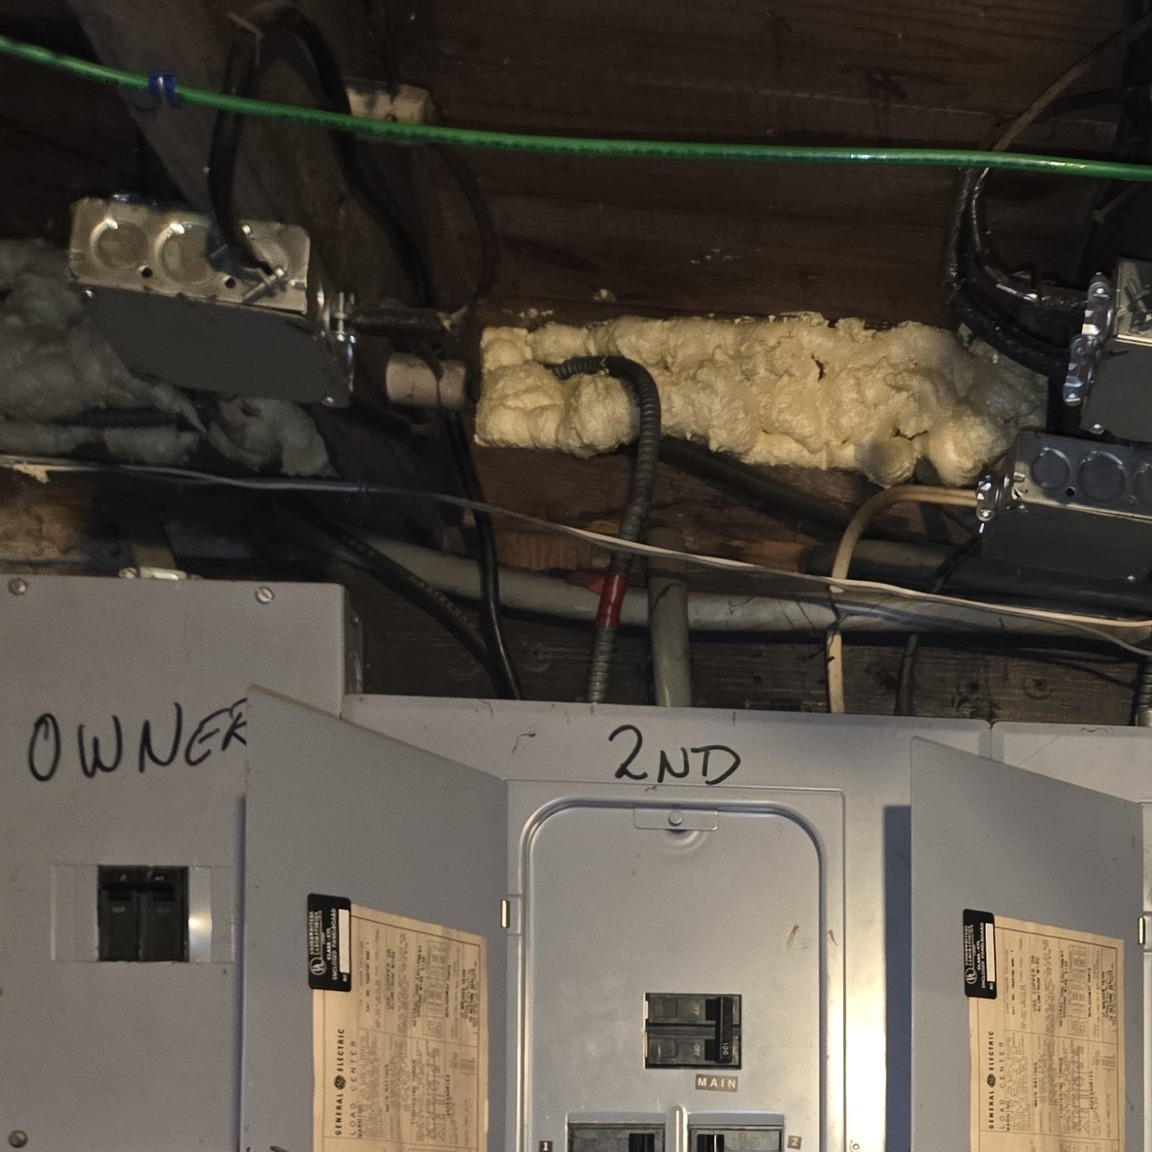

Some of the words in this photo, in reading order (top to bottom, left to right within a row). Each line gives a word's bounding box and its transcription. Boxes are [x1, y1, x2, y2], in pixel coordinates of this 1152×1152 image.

[608, 734, 742, 786] 2ND
[697, 1076, 736, 1089] MAIN
[335, 1093, 344, 1136] GENERAL
[543, 1141, 548, 1151] 1
[791, 1136, 799, 1146] 2
